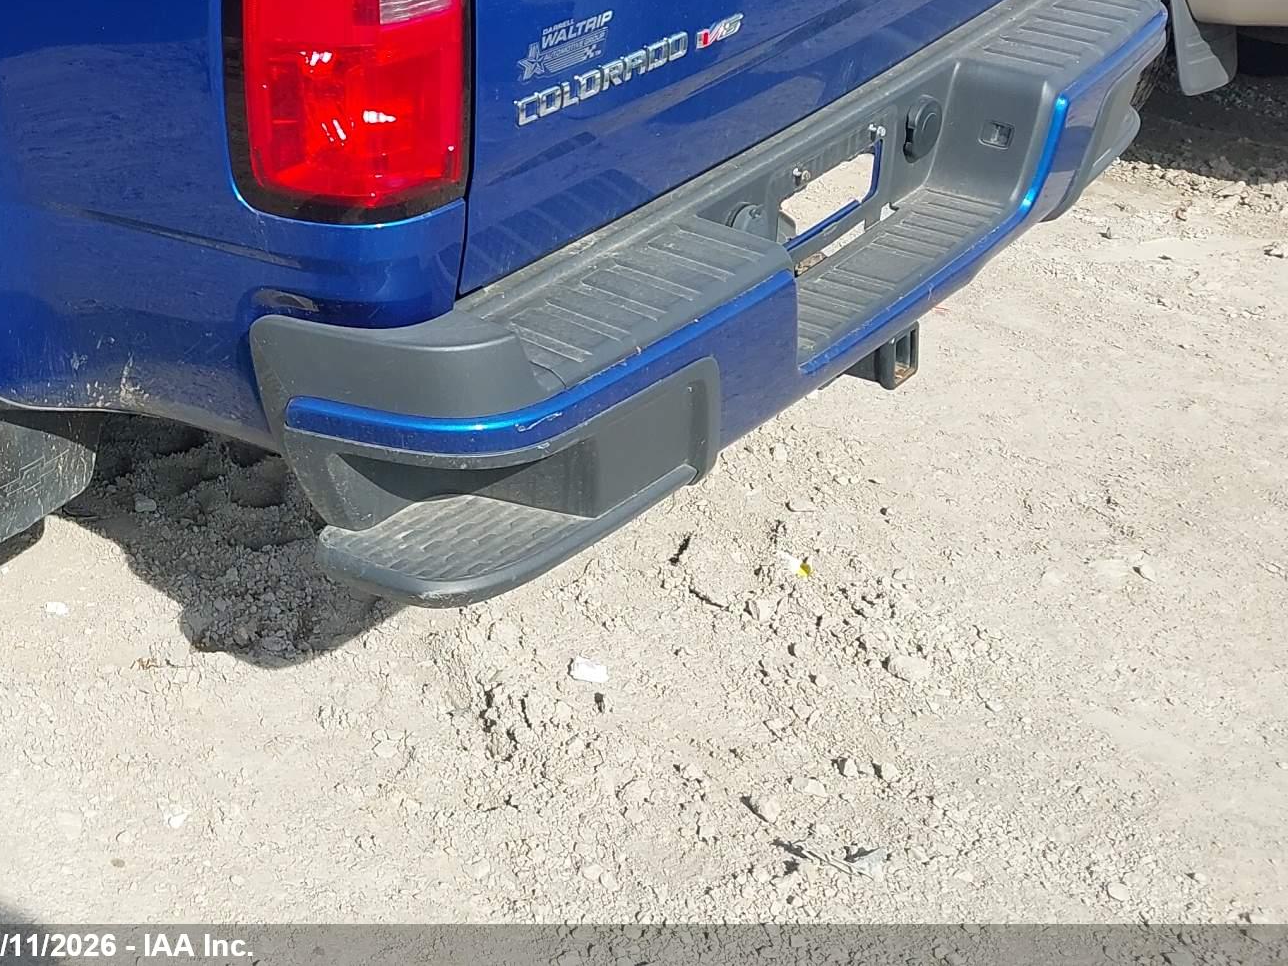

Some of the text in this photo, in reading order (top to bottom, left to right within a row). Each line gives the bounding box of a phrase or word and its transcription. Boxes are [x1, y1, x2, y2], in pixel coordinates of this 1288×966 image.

[541, 10, 613, 49] WALTRIP
[696, 13, 744, 50] V6
[514, 32, 688, 127] COLORADO
